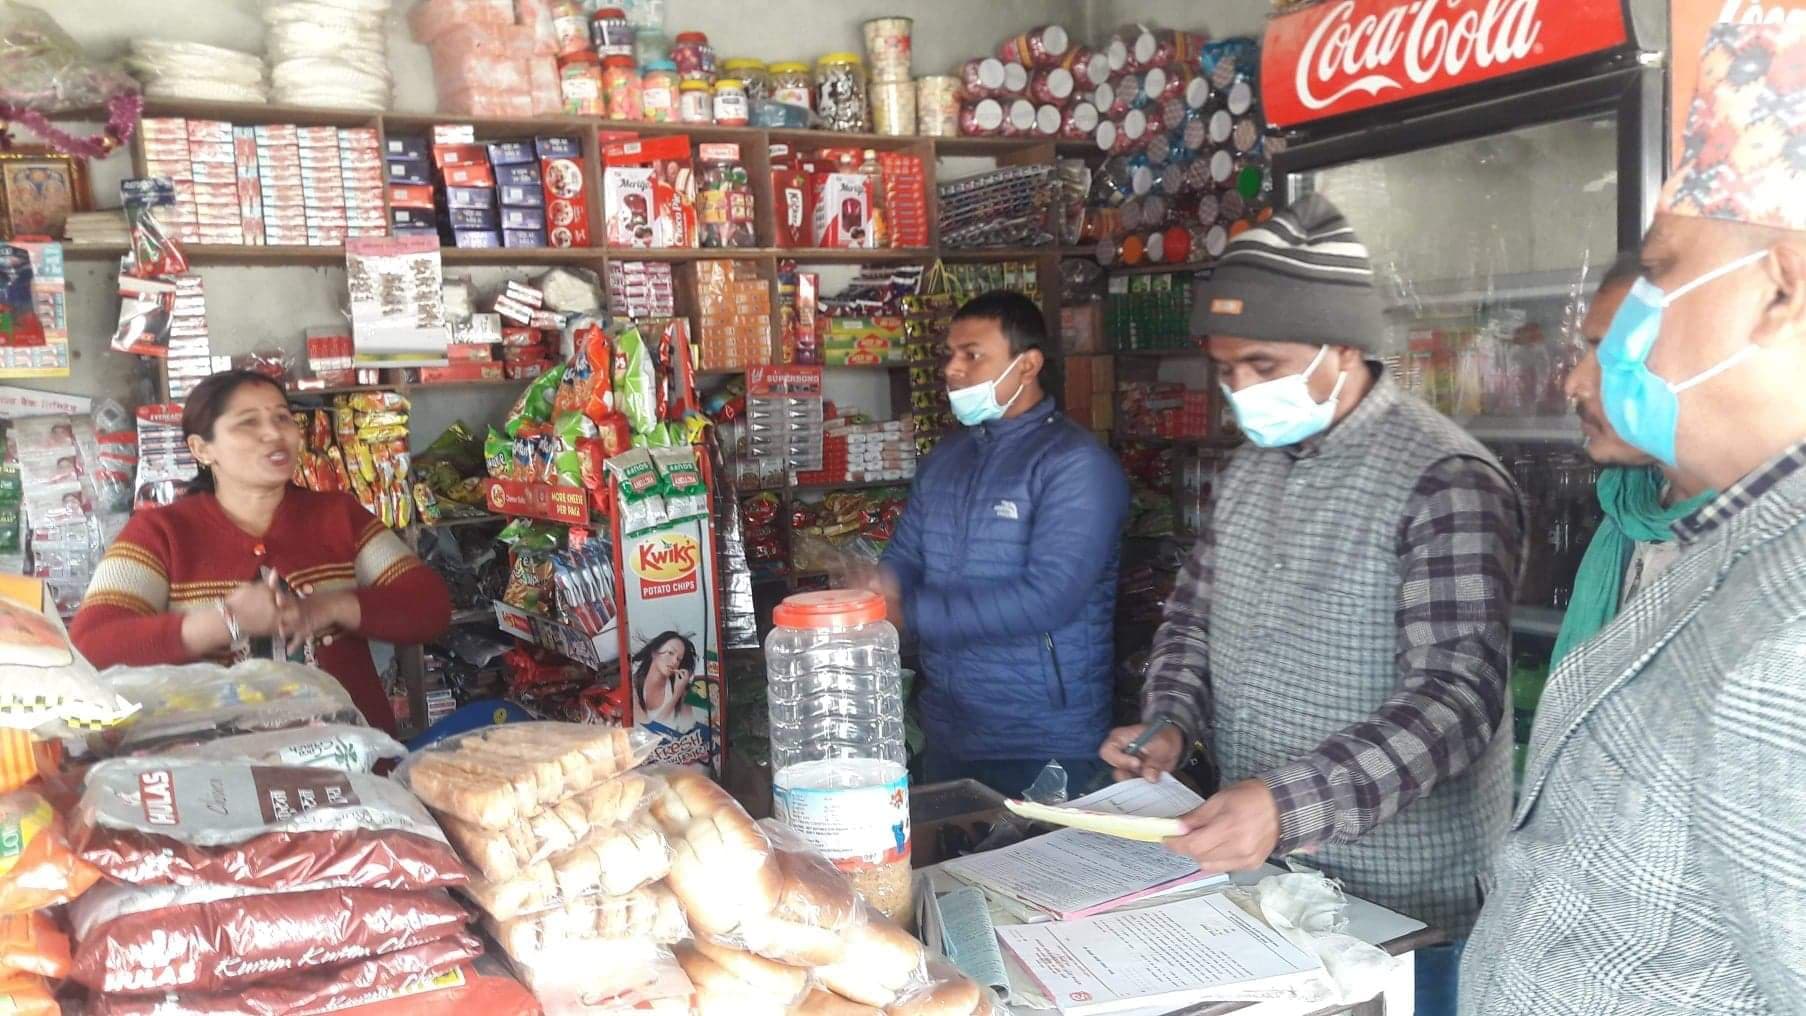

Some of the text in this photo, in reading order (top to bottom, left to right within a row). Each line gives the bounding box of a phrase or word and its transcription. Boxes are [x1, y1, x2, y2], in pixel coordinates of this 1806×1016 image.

[1296, 0, 1542, 109] Coca-Cola
[643, 580, 695, 596] POTATO CHIPS
[140, 770, 177, 825] HULAS
[103, 961, 197, 992] HULAS
